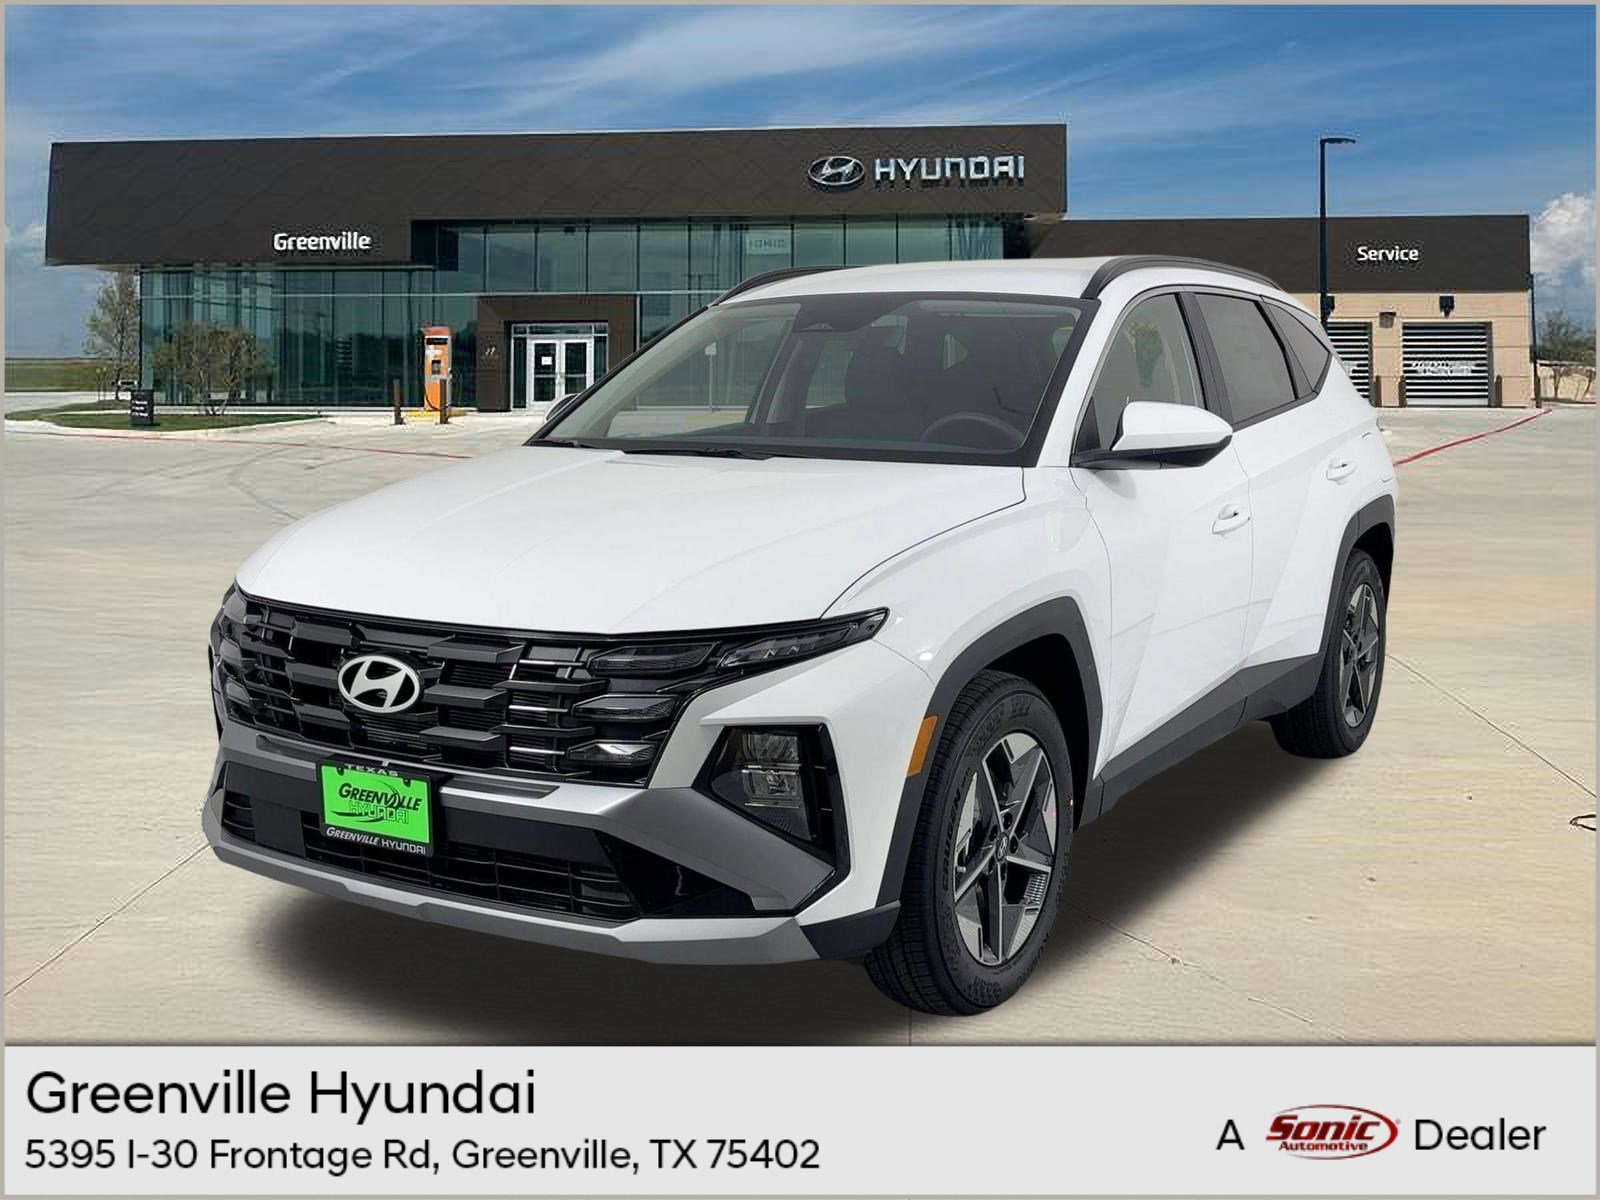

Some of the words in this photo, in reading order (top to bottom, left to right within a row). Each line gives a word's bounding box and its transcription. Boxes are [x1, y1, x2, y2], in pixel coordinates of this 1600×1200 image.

[875, 156, 1025, 180] HYUNDAI
[274, 231, 372, 250] Greenville
[1357, 245, 1419, 261] Service
[344, 763, 399, 777] TEXAS
[338, 783, 422, 811] GREENVILLE
[349, 801, 409, 824] HYUNDAI
[326, 827, 379, 845] GREENVILLE
[381, 838, 426, 855] HYUNDAI
